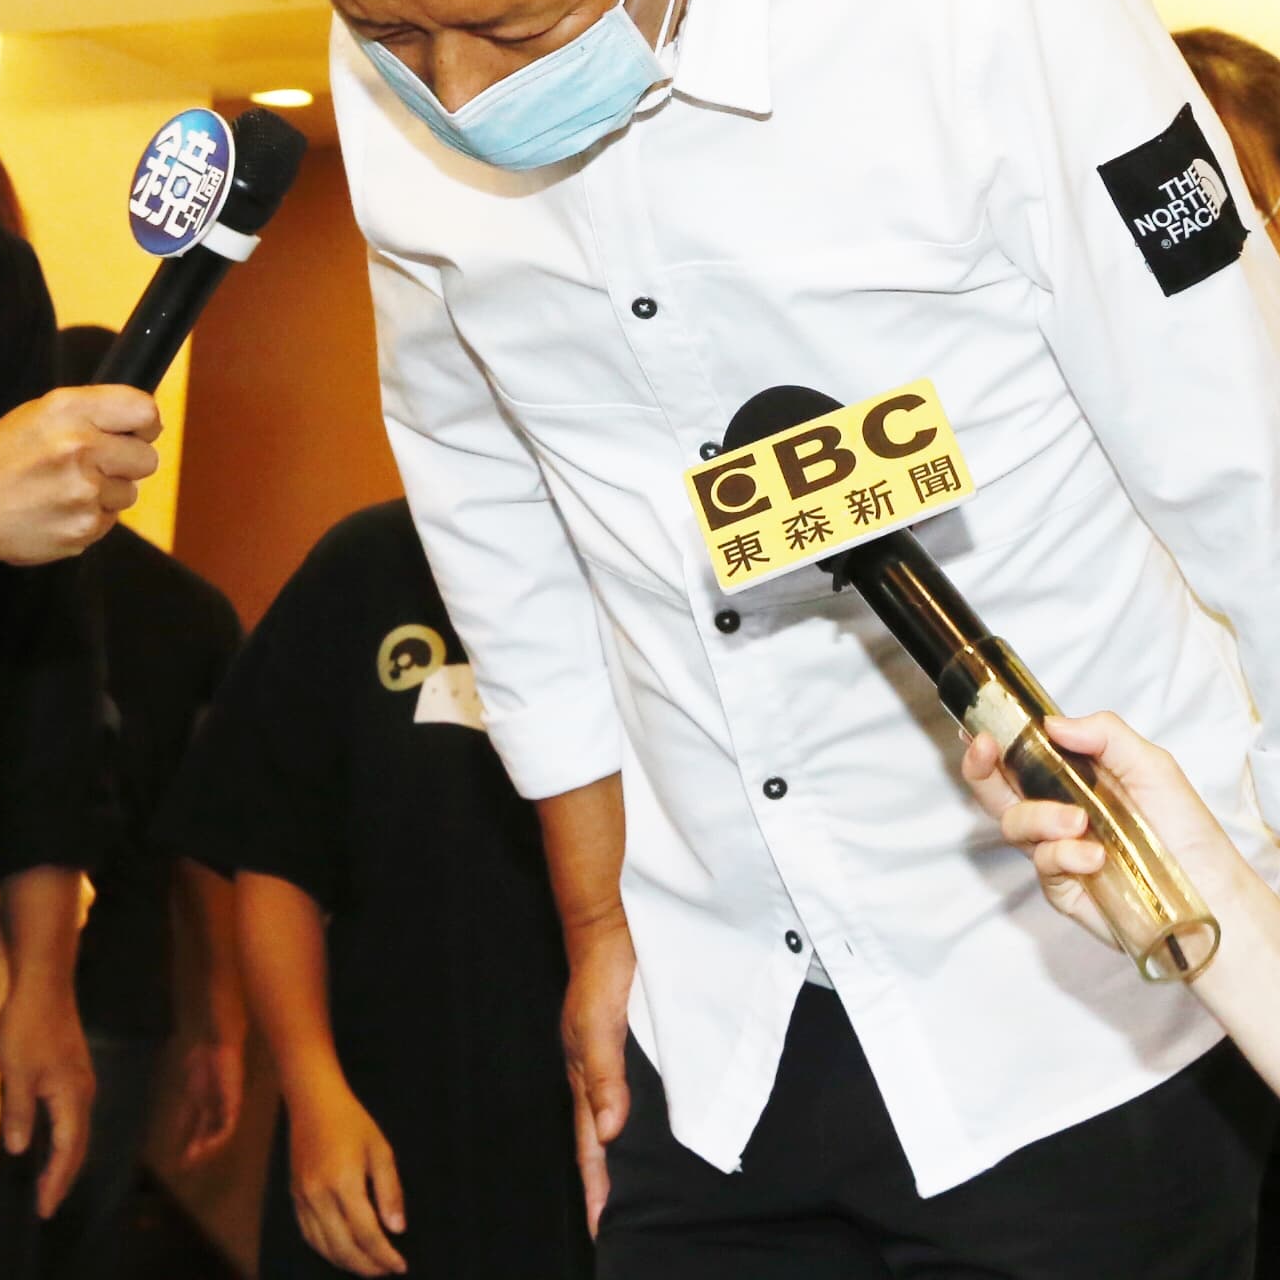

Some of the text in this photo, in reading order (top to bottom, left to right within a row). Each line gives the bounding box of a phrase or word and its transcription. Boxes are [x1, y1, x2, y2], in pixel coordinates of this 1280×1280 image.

[1157, 163, 1201, 202] THE
[1133, 186, 1212, 237] NORTH
[1166, 199, 1221, 244] FACE
[717, 454, 962, 578] 東森新聞
